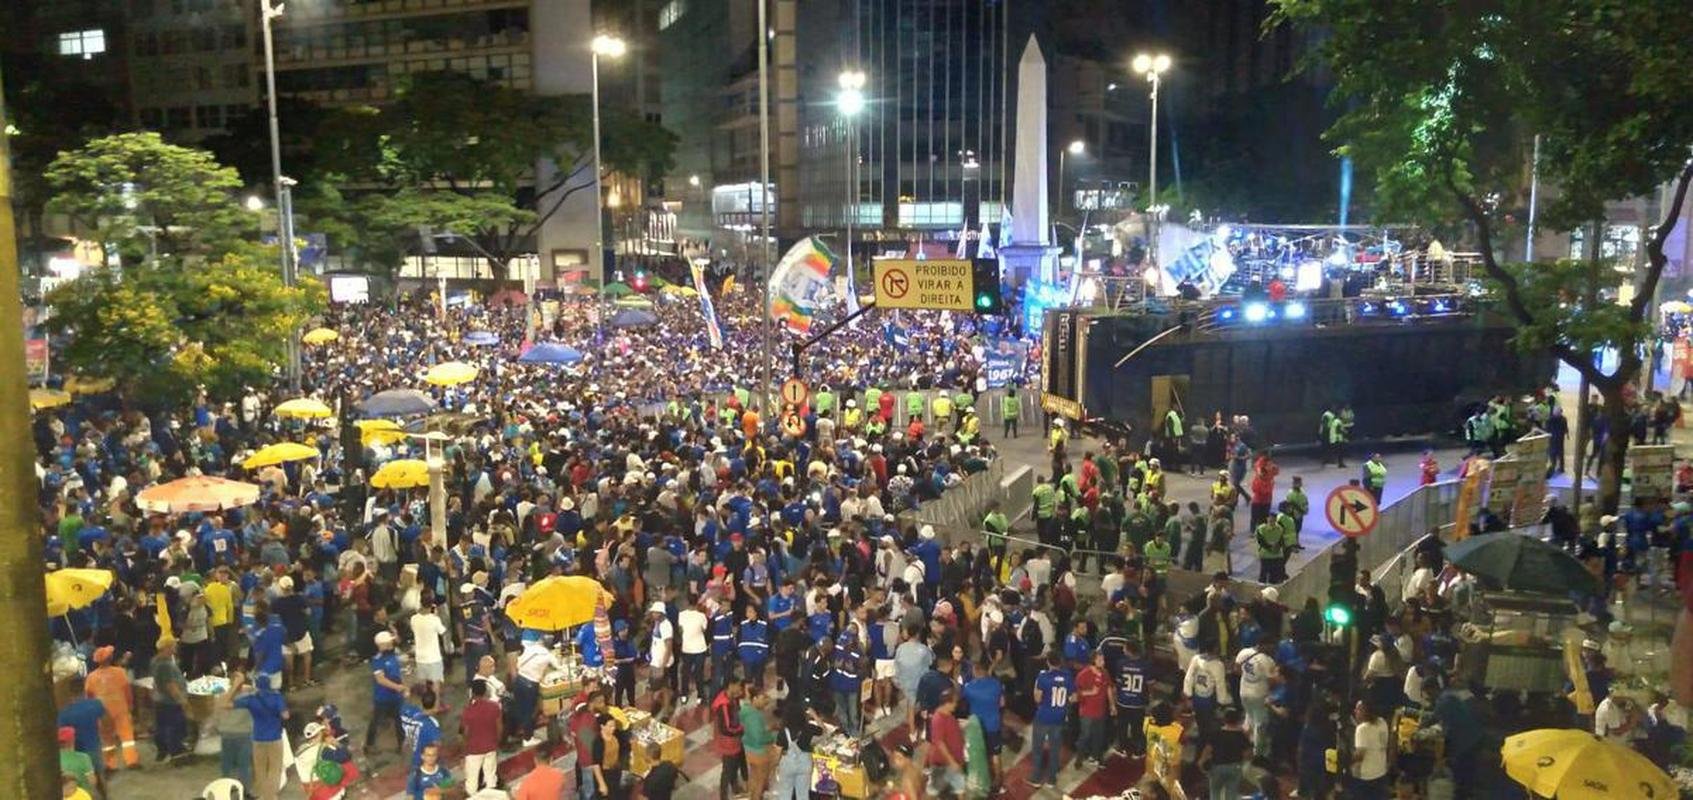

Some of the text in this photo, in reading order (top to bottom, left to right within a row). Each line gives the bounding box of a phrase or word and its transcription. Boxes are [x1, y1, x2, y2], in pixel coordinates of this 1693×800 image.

[915, 265, 966, 277] PROIBIDO
[917, 280, 964, 291] VIRAR A
[920, 294, 962, 305] DIREITA
[1122, 674, 1144, 692] 30
[1051, 686, 1067, 707] 10
